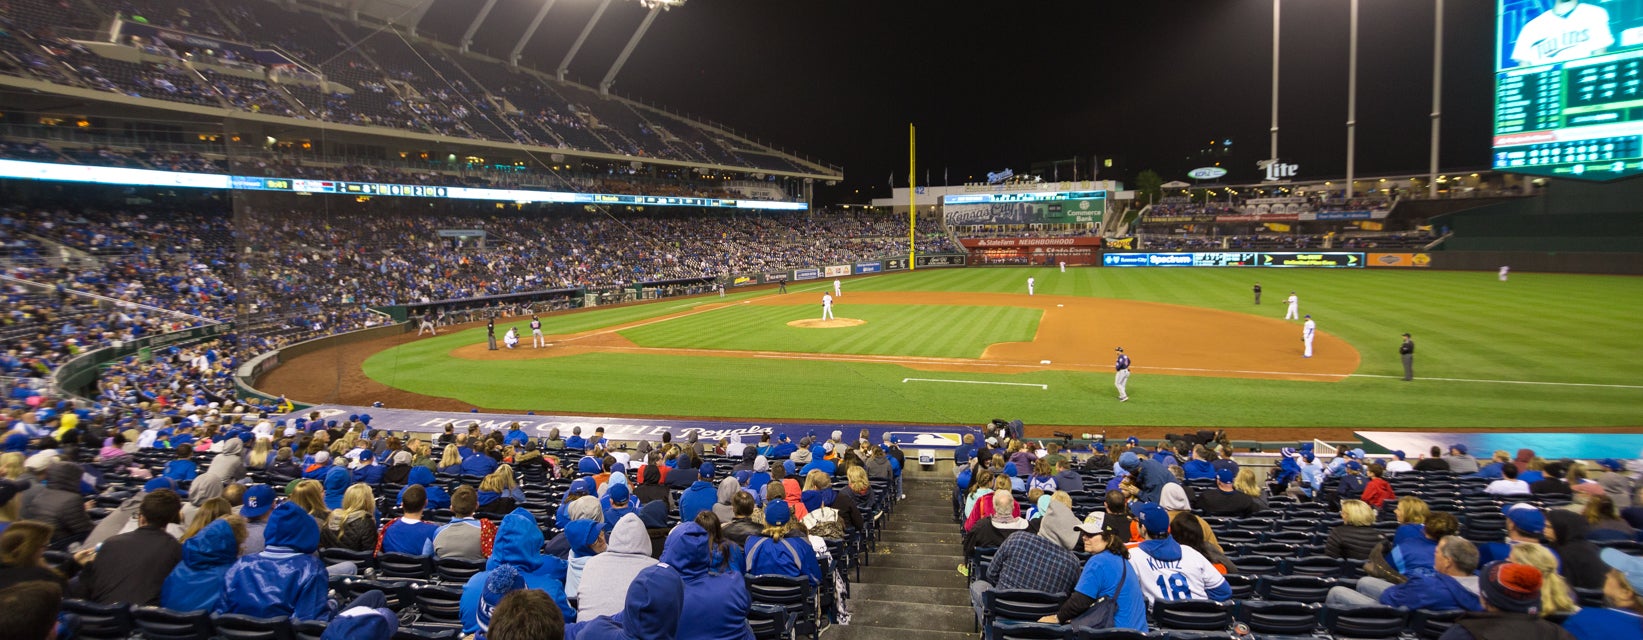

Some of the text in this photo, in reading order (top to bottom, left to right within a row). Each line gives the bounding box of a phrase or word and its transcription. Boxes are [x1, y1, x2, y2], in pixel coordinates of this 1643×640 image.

[1265, 162, 1299, 180] Lite
[1060, 181, 1072, 191] 20
[946, 202, 1015, 225] Kansas City
[1151, 255, 1191, 264] Spectrum
[418, 417, 534, 430] HOME
[676, 425, 773, 440] Royals
[1146, 557, 1182, 571] KUNTZ
[1156, 572, 1192, 600] 18
